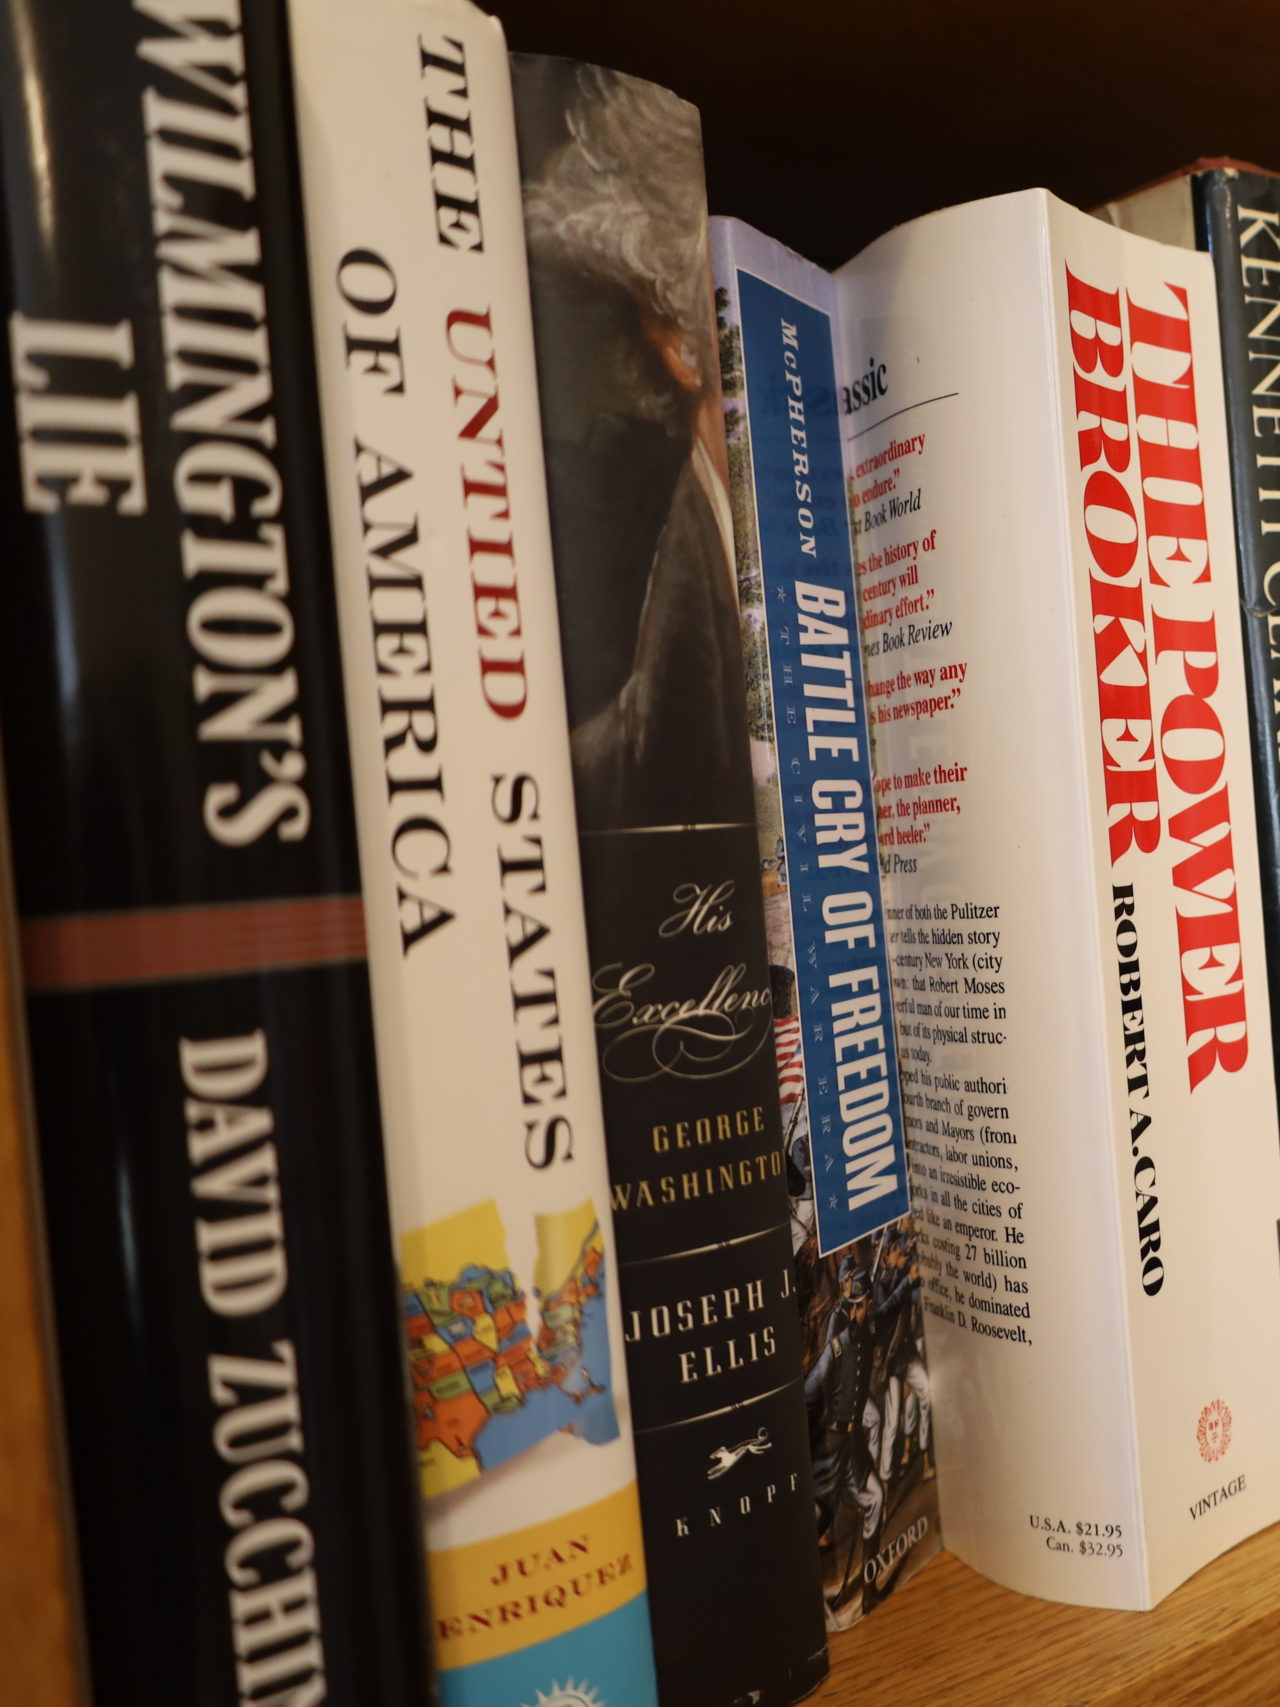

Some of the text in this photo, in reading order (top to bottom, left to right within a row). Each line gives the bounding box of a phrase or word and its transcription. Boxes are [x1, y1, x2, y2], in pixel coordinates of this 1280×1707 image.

[8, 309, 147, 518] LIE
[855, 433, 926, 480] extraordinary
[864, 502, 887, 533] Book
[889, 487, 922, 520] World
[868, 552, 883, 573] the
[884, 540, 919, 566] history
[922, 529, 937, 553] of
[1064, 257, 1161, 868] BROKER
[336, 246, 459, 958] OF AMERICA
[419, 32, 576, 1172] THE UNTIED STATES
[862, 564, 919, 603] century will
[882, 619, 953, 654] Book Review
[896, 662, 968, 692] the way any
[1125, 281, 1250, 1096] THE POWER
[877, 704, 892, 725] his
[893, 761, 968, 791] to make their
[896, 795, 961, 821] the planner,
[893, 854, 918, 874] Press
[658, 880, 736, 938] His
[779, 626, 835, 1173] THE CIVIL WAR ERA
[795, 580, 899, 1212] BATTLE CRY OF FREEDOM
[914, 901, 1000, 921] both the Pulitzer
[900, 928, 916, 945] tells
[918, 928, 931, 946] the
[931, 928, 964, 946] hidden
[967, 931, 1001, 949] story
[924, 952, 943, 969] New
[944, 952, 970, 970] York
[972, 952, 1003, 974] (city
[592, 963, 773, 1040] Excellenc
[912, 975, 927, 992] that
[928, 976, 960, 994] Robert
[964, 977, 1006, 995] Moses
[1112, 881, 1151, 1099] ROBERT
[916, 1000, 1007, 1020] man of our time in
[912, 1022, 1008, 1046] of its physical struc-
[911, 1044, 932, 1067] today.
[921, 1068, 933, 1087] his
[934, 1073, 960, 1093] public
[925, 1093, 1010, 1122] branch of govern
[652, 1106, 764, 1155] GEORGE
[925, 1118, 940, 1136] and
[941, 1119, 975, 1143] Mayors
[980, 1125, 1018, 1147] (from
[178, 1027, 290, 1318] DAVID
[945, 1144, 1019, 1174] labor unions,
[609, 1147, 786, 1212] WASHINGTO
[928, 1167, 938, 1182] an
[940, 1166, 987, 1192] irresistible
[991, 1179, 1021, 1195] eco-
[930, 1185, 939, 1203] in
[940, 1190, 952, 1208] all
[953, 1194, 969, 1212] the
[972, 1197, 1003, 1219] cities
[1008, 1201, 1024, 1220] of
[926, 1208, 941, 1227] like
[943, 1217, 953, 1232] an
[955, 1221, 999, 1243] emperor.
[1004, 1226, 1026, 1245] He
[932, 1236, 961, 1261] costing
[965, 1243, 978, 1261] 27
[983, 1247, 1028, 1270] billion
[945, 1260, 960, 1280] the
[963, 1270, 998, 1293] world)
[1004, 1274, 1030, 1295] has
[625, 1268, 797, 1343] JOSEPH J.
[923, 1295, 1033, 1347] Franklin D. Roosevelt,
[954, 1286, 966, 1306] he
[968, 1291, 1031, 1319] dominated
[678, 1326, 777, 1385] ELLIS
[1188, 1473, 1247, 1522] VINTAGE
[1029, 1514, 1123, 1539] U.S.A. $21.95
[489, 1534, 591, 1588] JUAN
[863, 1514, 930, 1588] OXFORD
[1046, 1536, 1124, 1558] Can. $32.95
[436, 1553, 634, 1641] ENRIQUEZ
